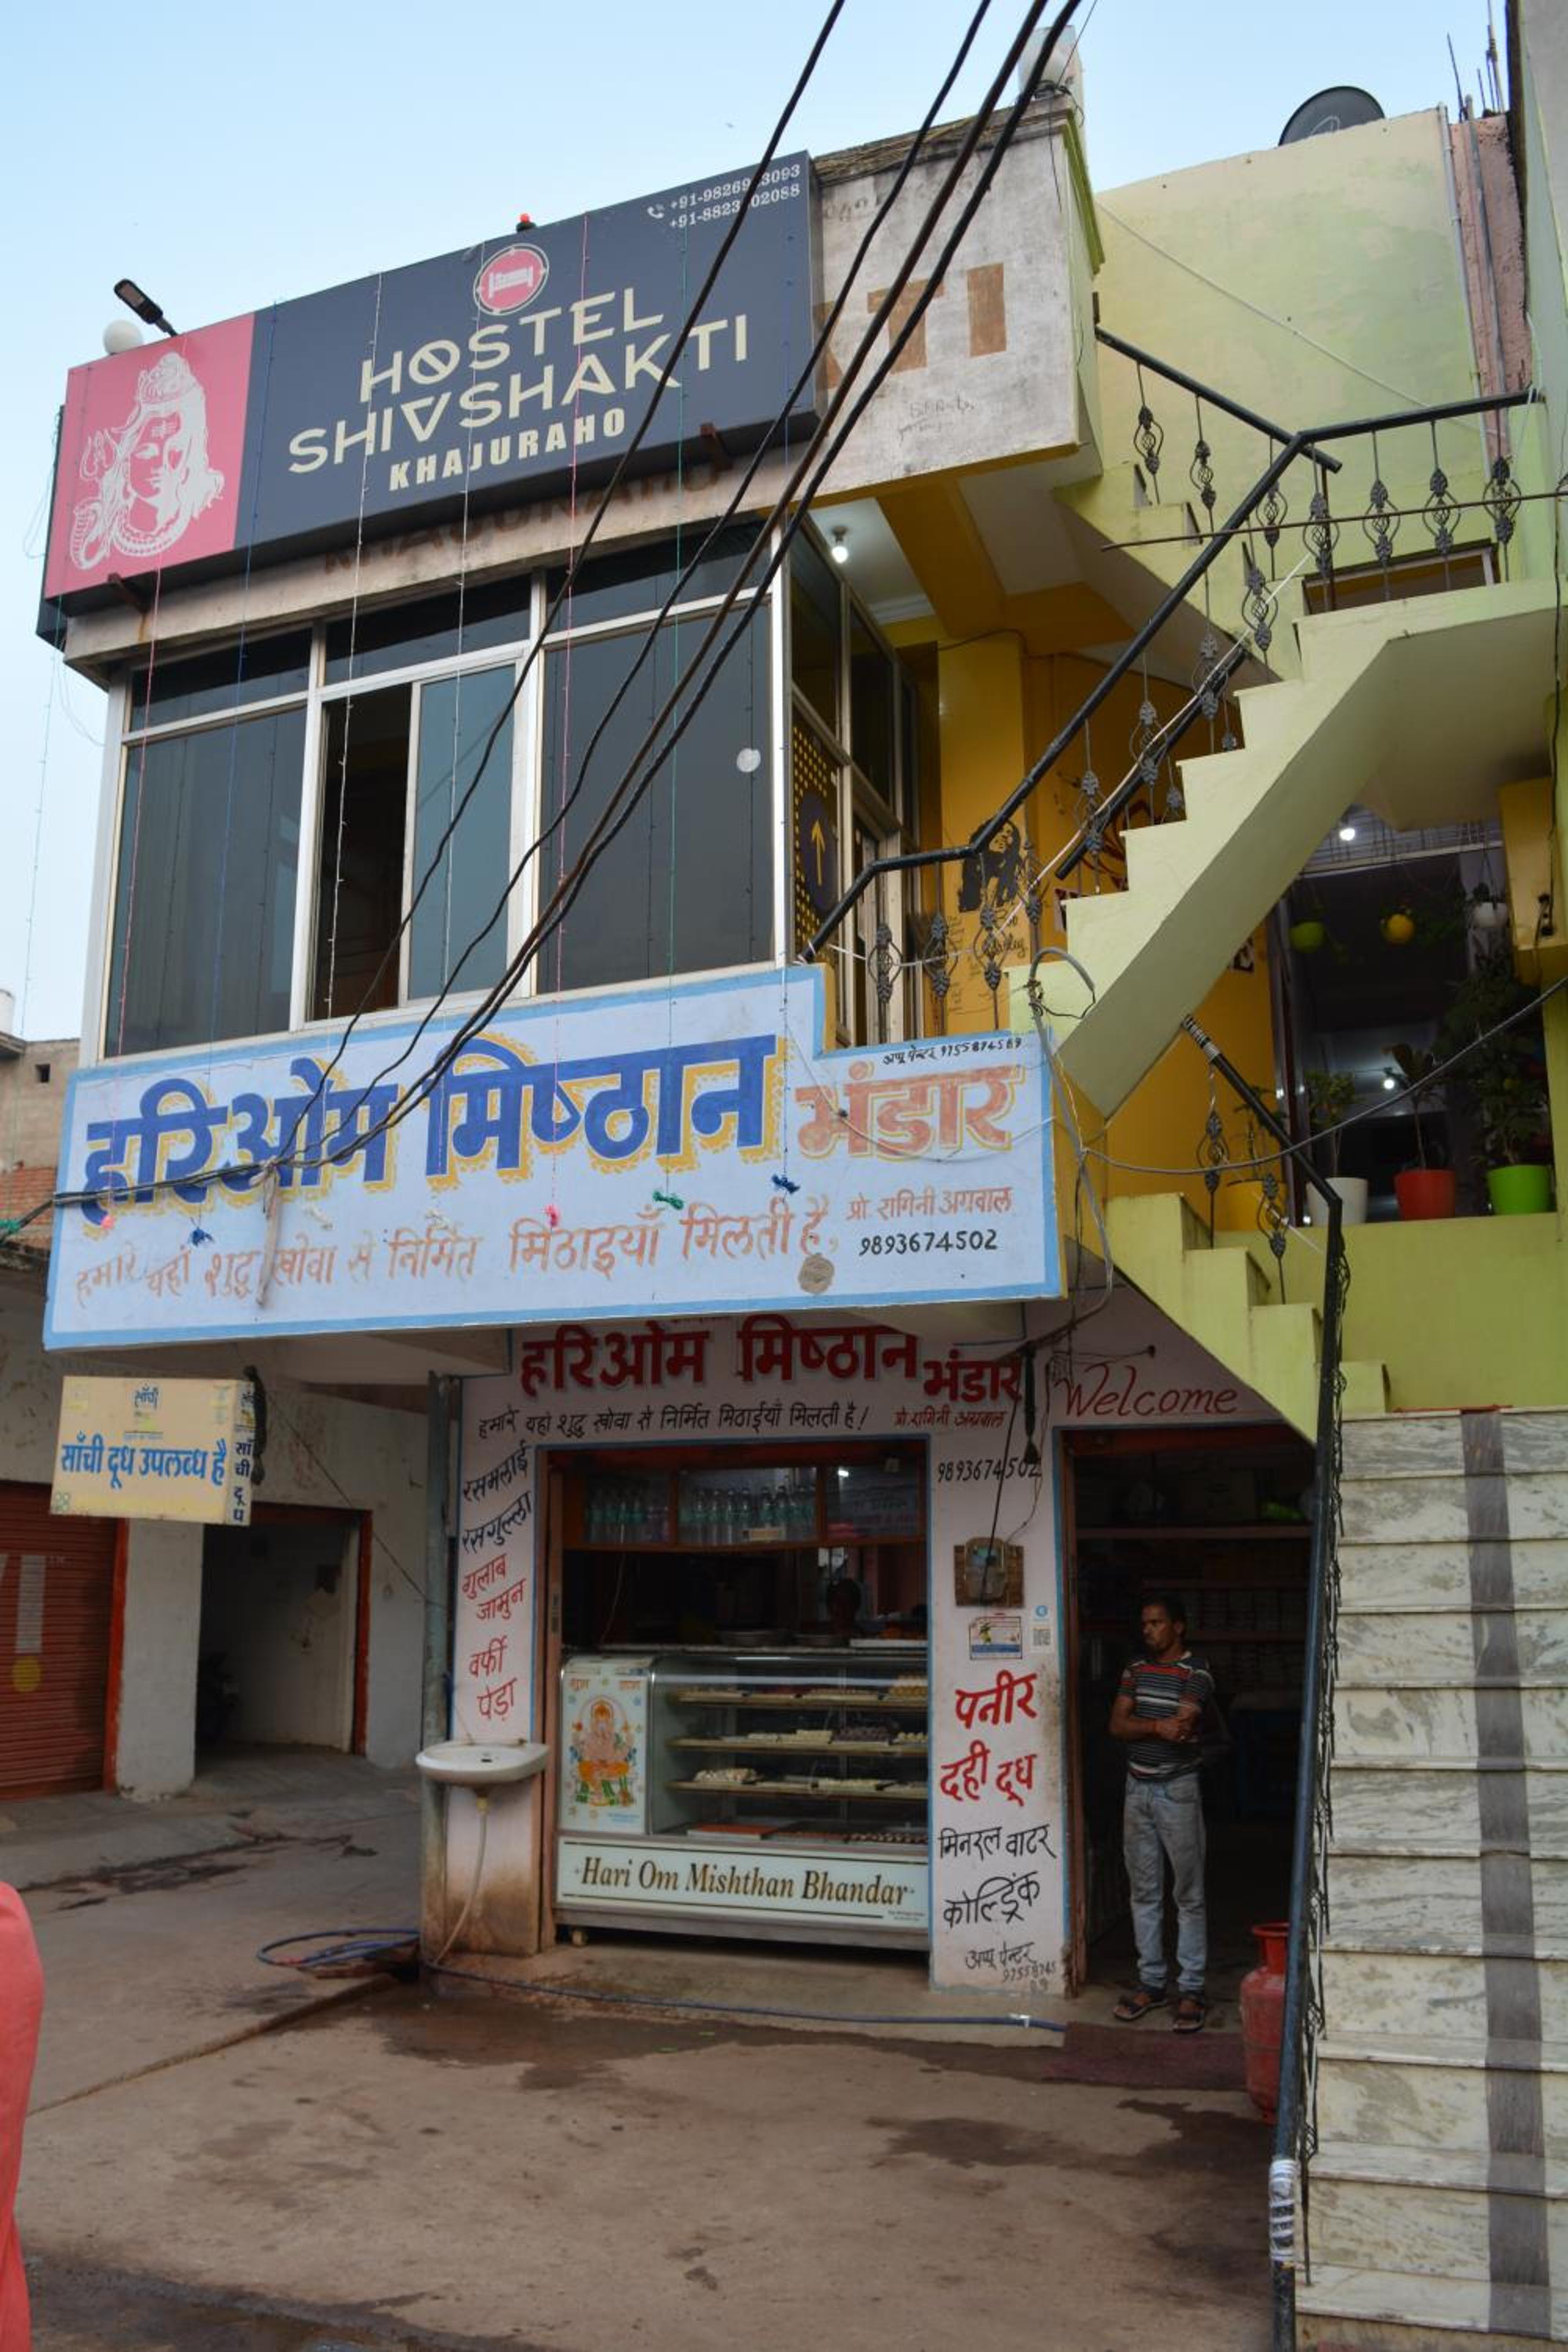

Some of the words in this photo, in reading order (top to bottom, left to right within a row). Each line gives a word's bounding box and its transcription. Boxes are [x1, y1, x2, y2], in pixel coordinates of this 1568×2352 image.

[359, 288, 664, 403] HOSTEL
[289, 314, 747, 474] SHIVSHAKTI
[389, 407, 626, 492] KHAJURAHO
[794, 1061, 1025, 1160] भंडार
[680, 1199, 792, 1259] मिलती
[858, 1229, 998, 1257] 9893674502
[521, 1319, 711, 1398] हरिओम
[737, 1314, 918, 1381] मिष्ठान
[924, 1348, 1022, 1403] भंडार
[789, 1401, 844, 1428] मिलती
[1054, 1363, 1238, 1417] Welcome
[107, 1446, 136, 1489] दूध
[211, 1438, 227, 1486] है
[463, 1439, 532, 1502] रसमलाई
[462, 1491, 532, 1554] रसगुल्ला
[476, 1578, 527, 1621] जामुन
[955, 1669, 1037, 1730] पनीर
[940, 1739, 991, 1802] दही
[996, 1753, 1038, 1807] दूध
[938, 1827, 1004, 1862] मिनरल
[1006, 1824, 1058, 1859] वाटर
[582, 1857, 633, 1888] Hari
[638, 1860, 679, 1890] Om
[686, 1863, 794, 1898] Mishthan
[802, 1870, 909, 1906] Bhandar
